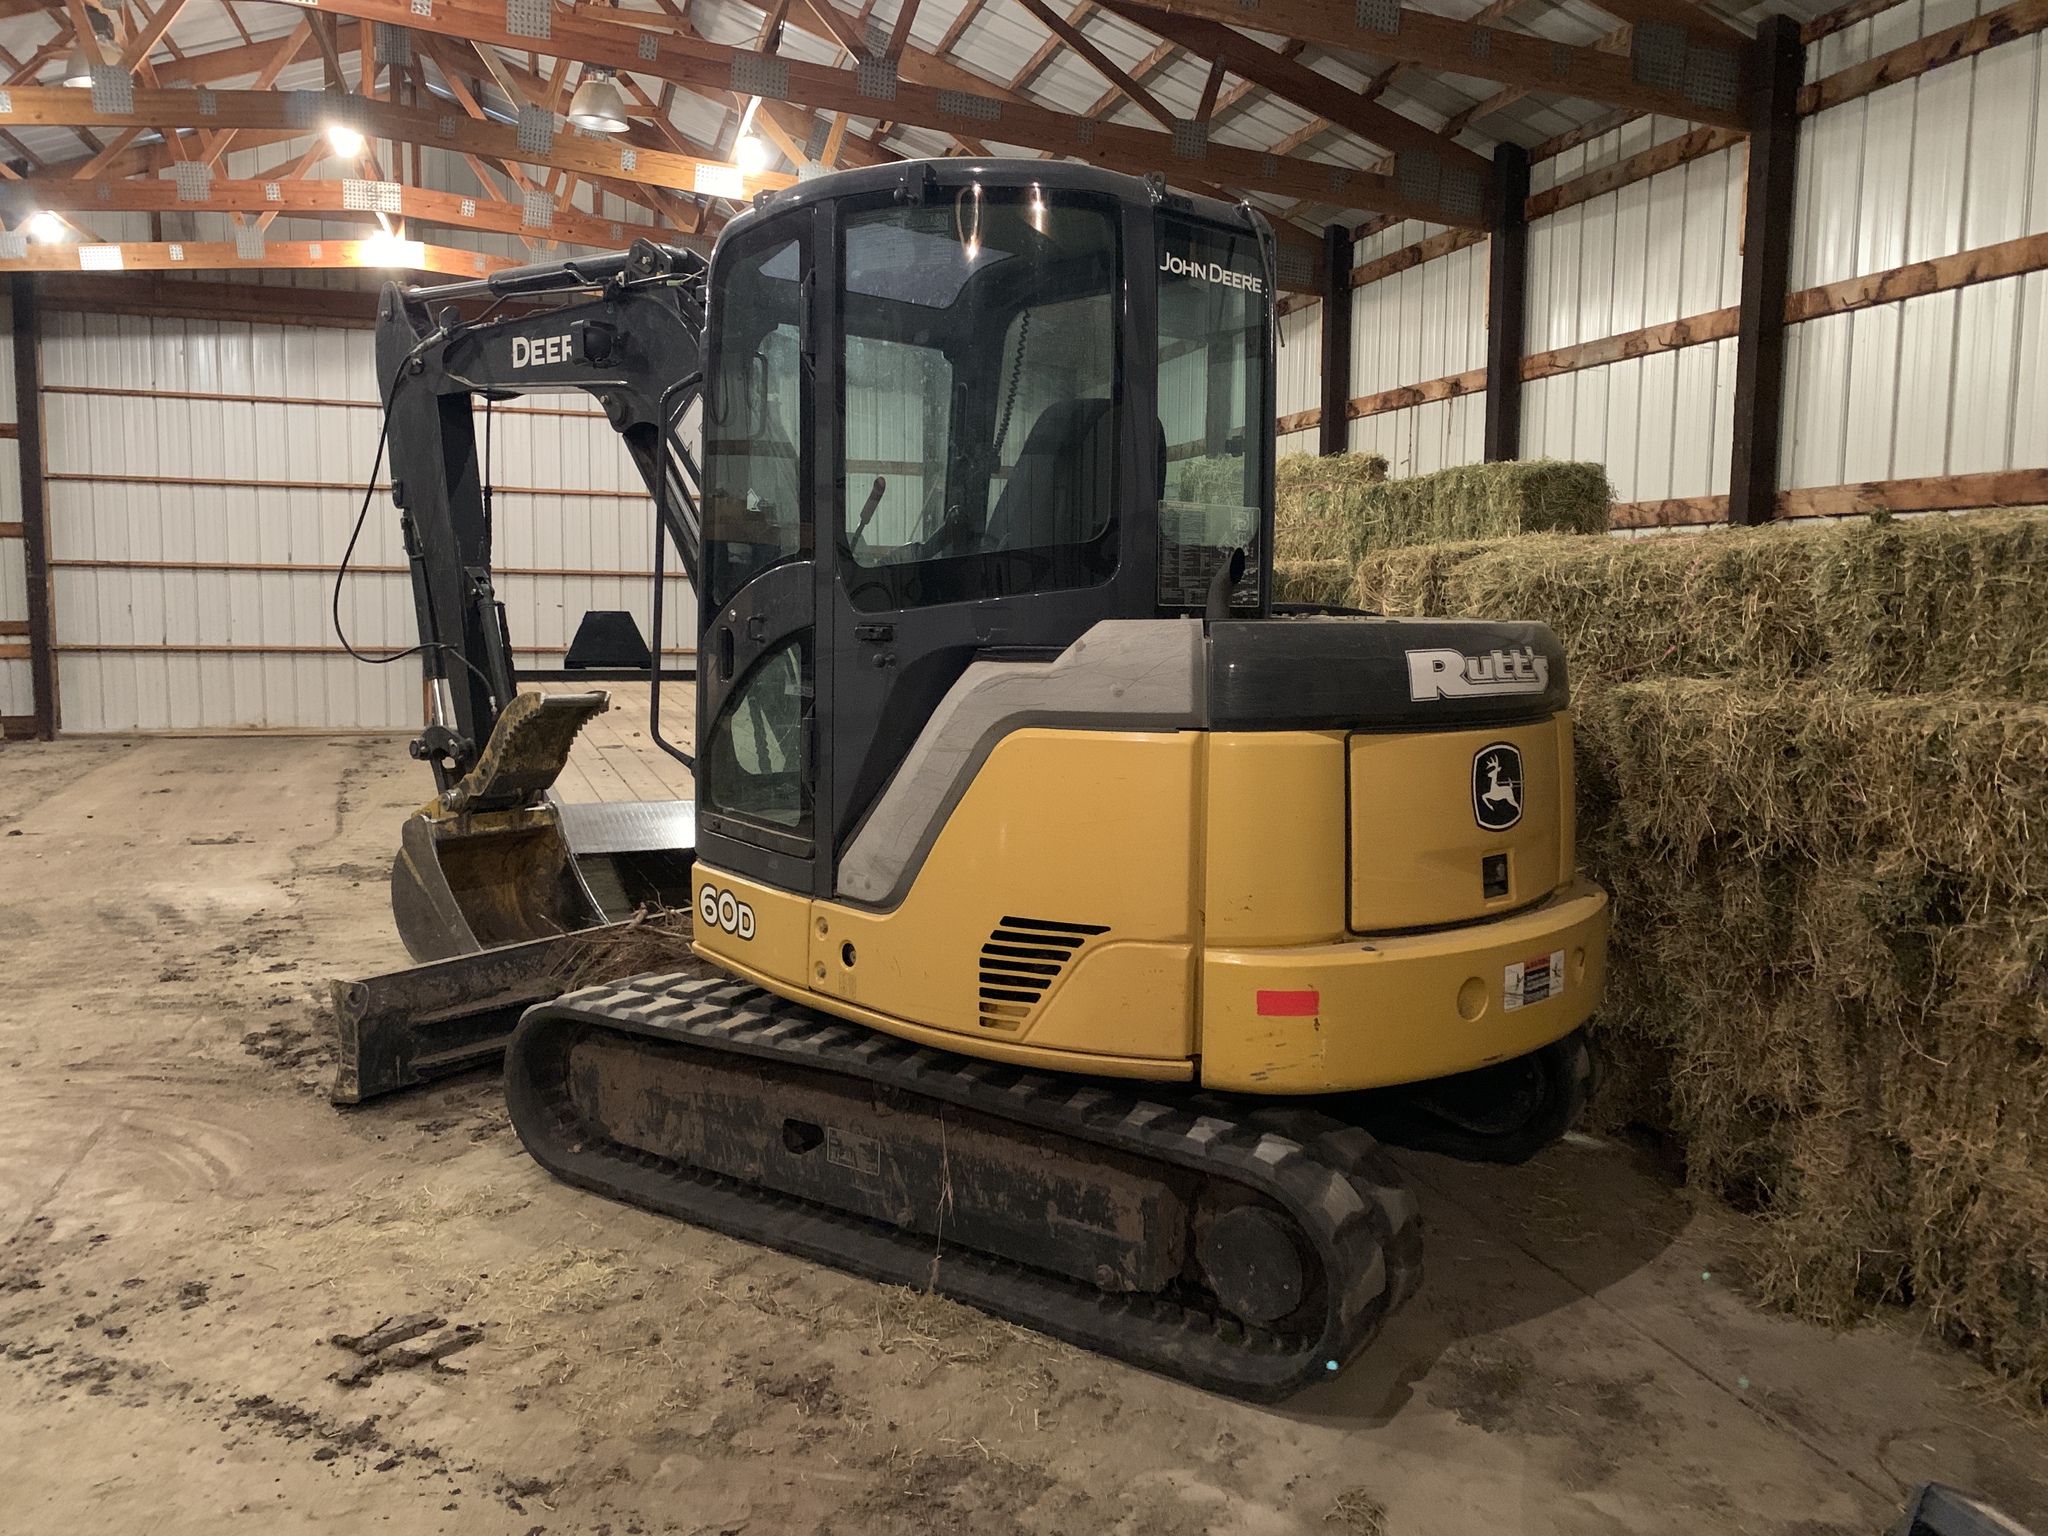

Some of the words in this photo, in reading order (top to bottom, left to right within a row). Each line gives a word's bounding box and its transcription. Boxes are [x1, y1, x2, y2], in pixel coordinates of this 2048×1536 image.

[1160, 251, 1207, 281] JOHN
[1209, 262, 1263, 294] DEERE
[511, 334, 573, 369] DEER
[1405, 646, 1550, 702] Rutt's
[699, 883, 756, 942] 60D
